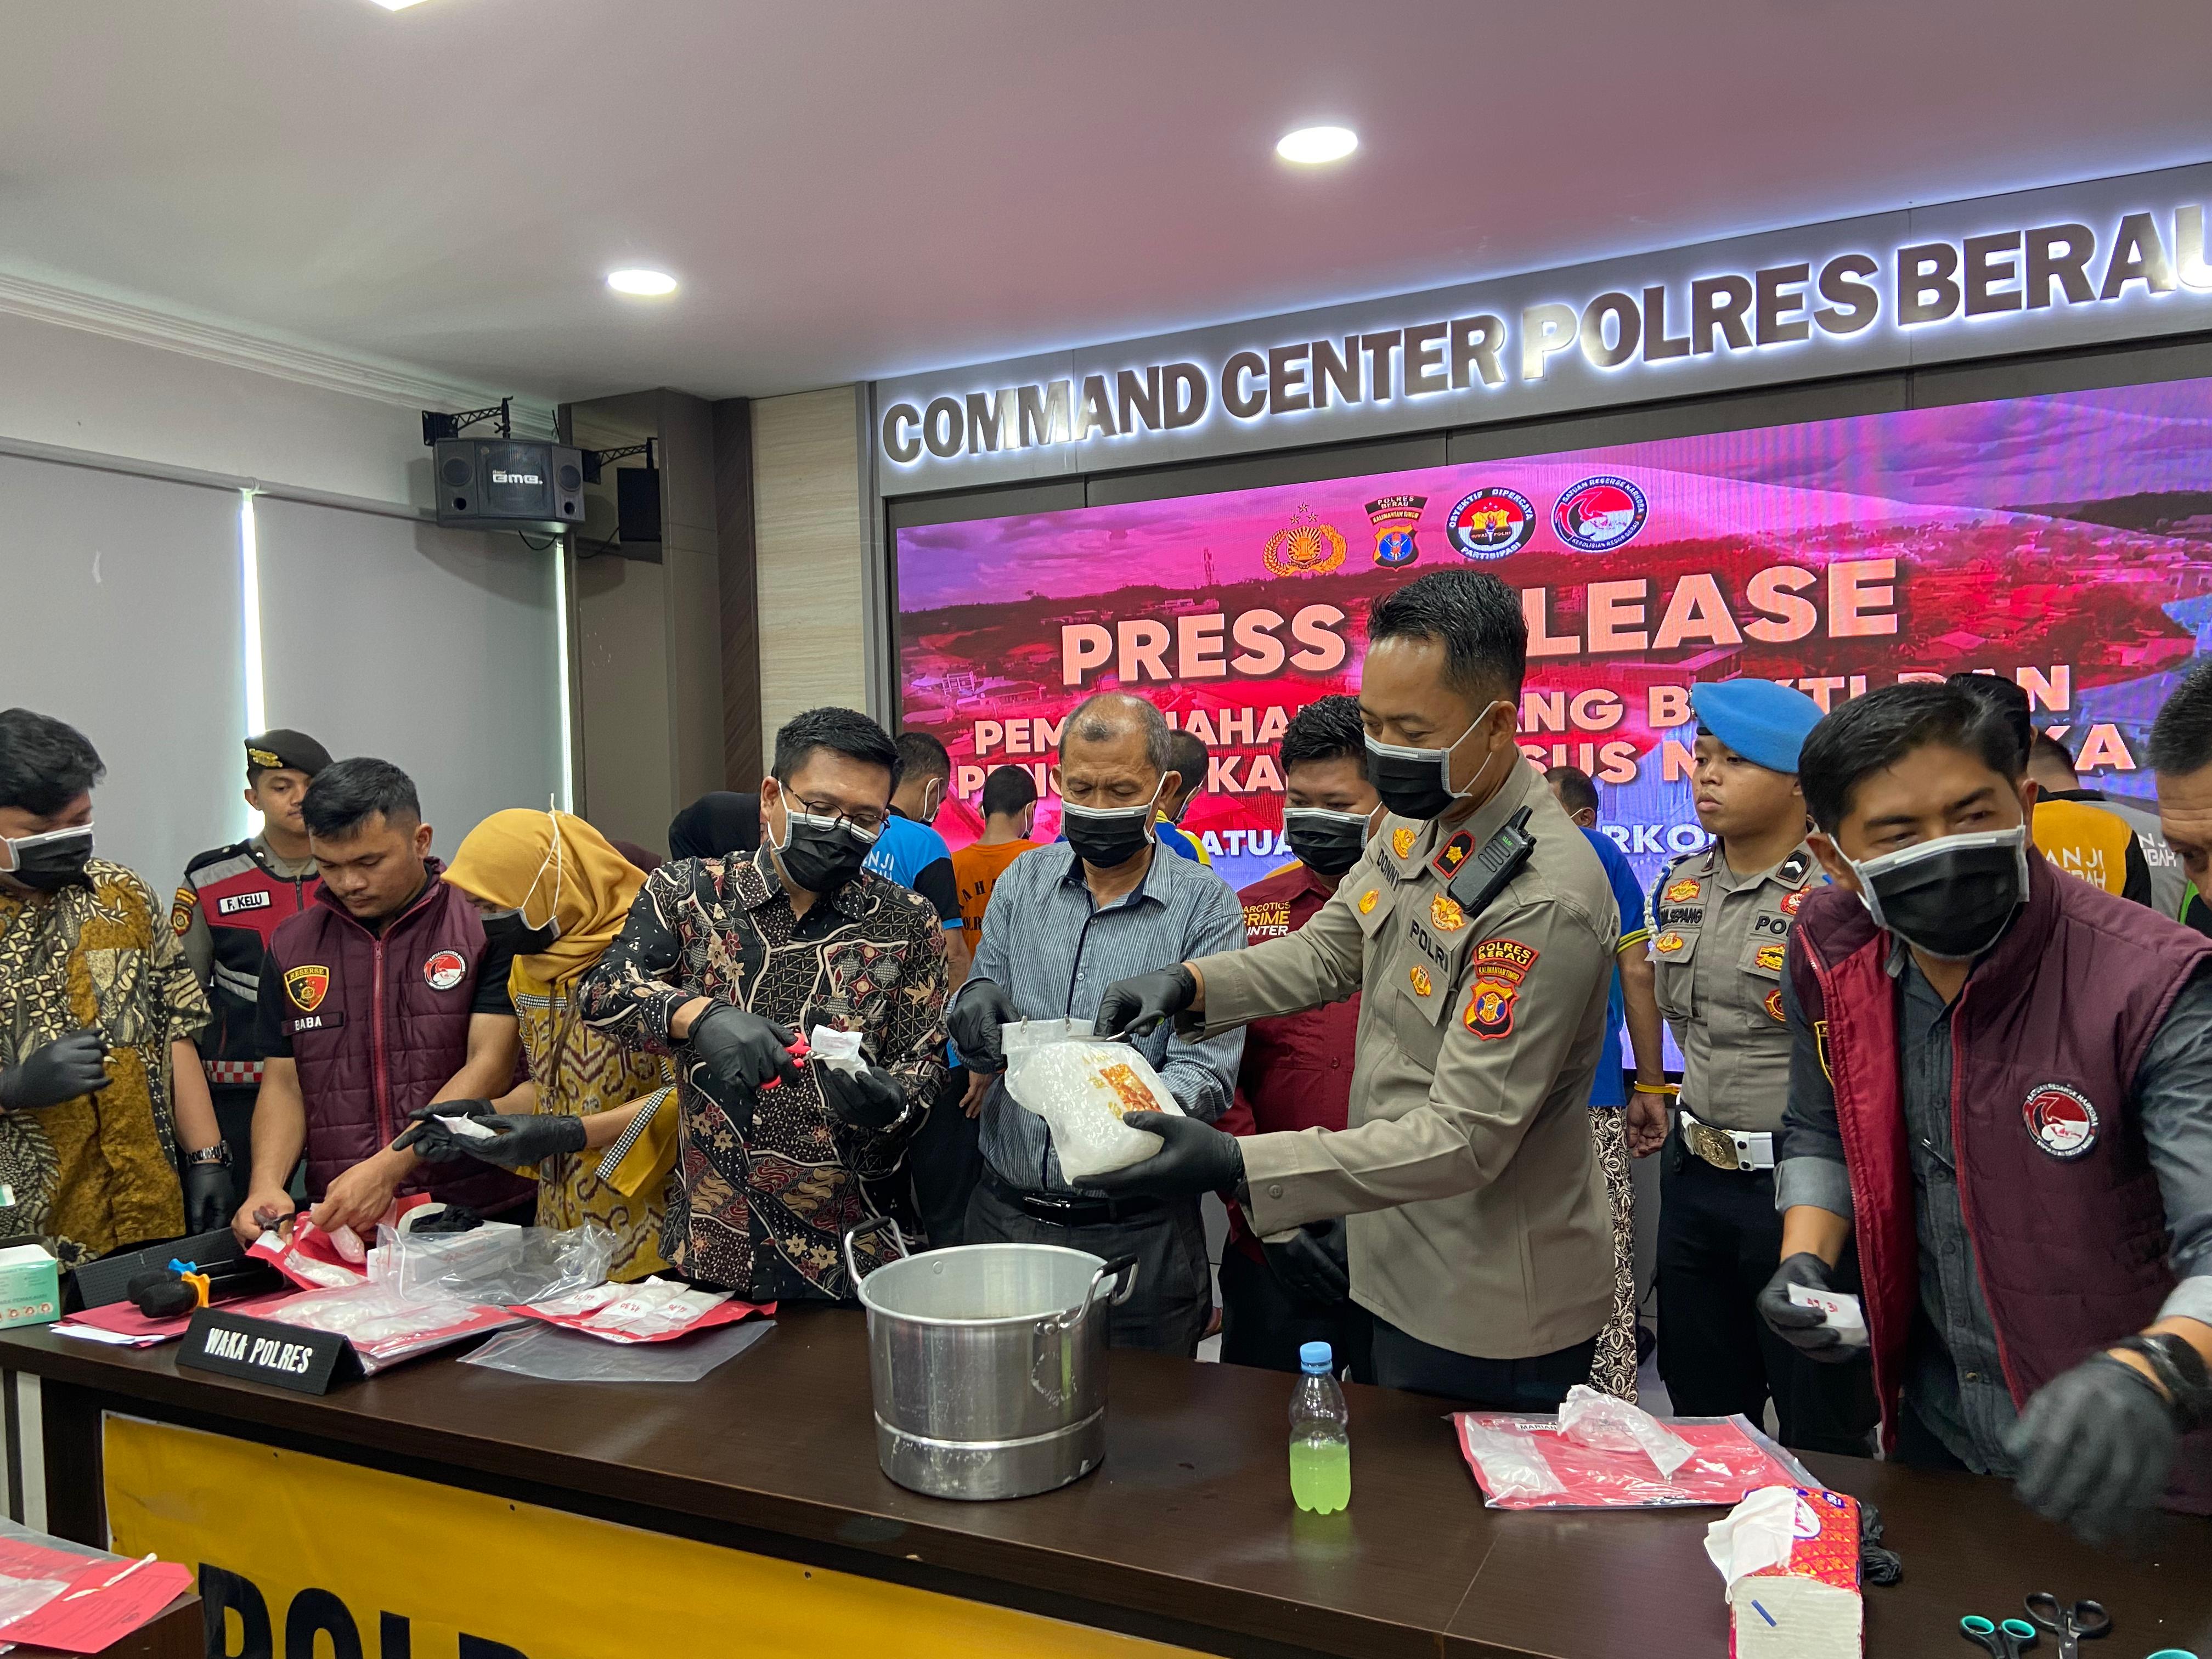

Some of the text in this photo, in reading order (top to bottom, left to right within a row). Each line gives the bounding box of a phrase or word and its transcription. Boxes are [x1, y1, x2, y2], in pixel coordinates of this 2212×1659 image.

[882, 362, 1208, 464] COMMAND
[1221, 314, 1505, 419] CENTER
[1522, 253, 1879, 381] POLRES
[1378, 495, 1414, 505] POLRES
[1062, 557, 1898, 686] PRESS LEASE
[1376, 848, 1400, 891] DONNY
[227, 899, 235, 910] F.
[1243, 901, 1291, 913] ARCOTICS
[1409, 919, 1448, 973] POLRI
[1478, 941, 1532, 959] POLRES
[1478, 951, 1527, 964] BERAU
[290, 968, 324, 979] RESERSE
[295, 1015, 322, 1031] BABA
[204, 1328, 313, 1374] WAKA POLRES
